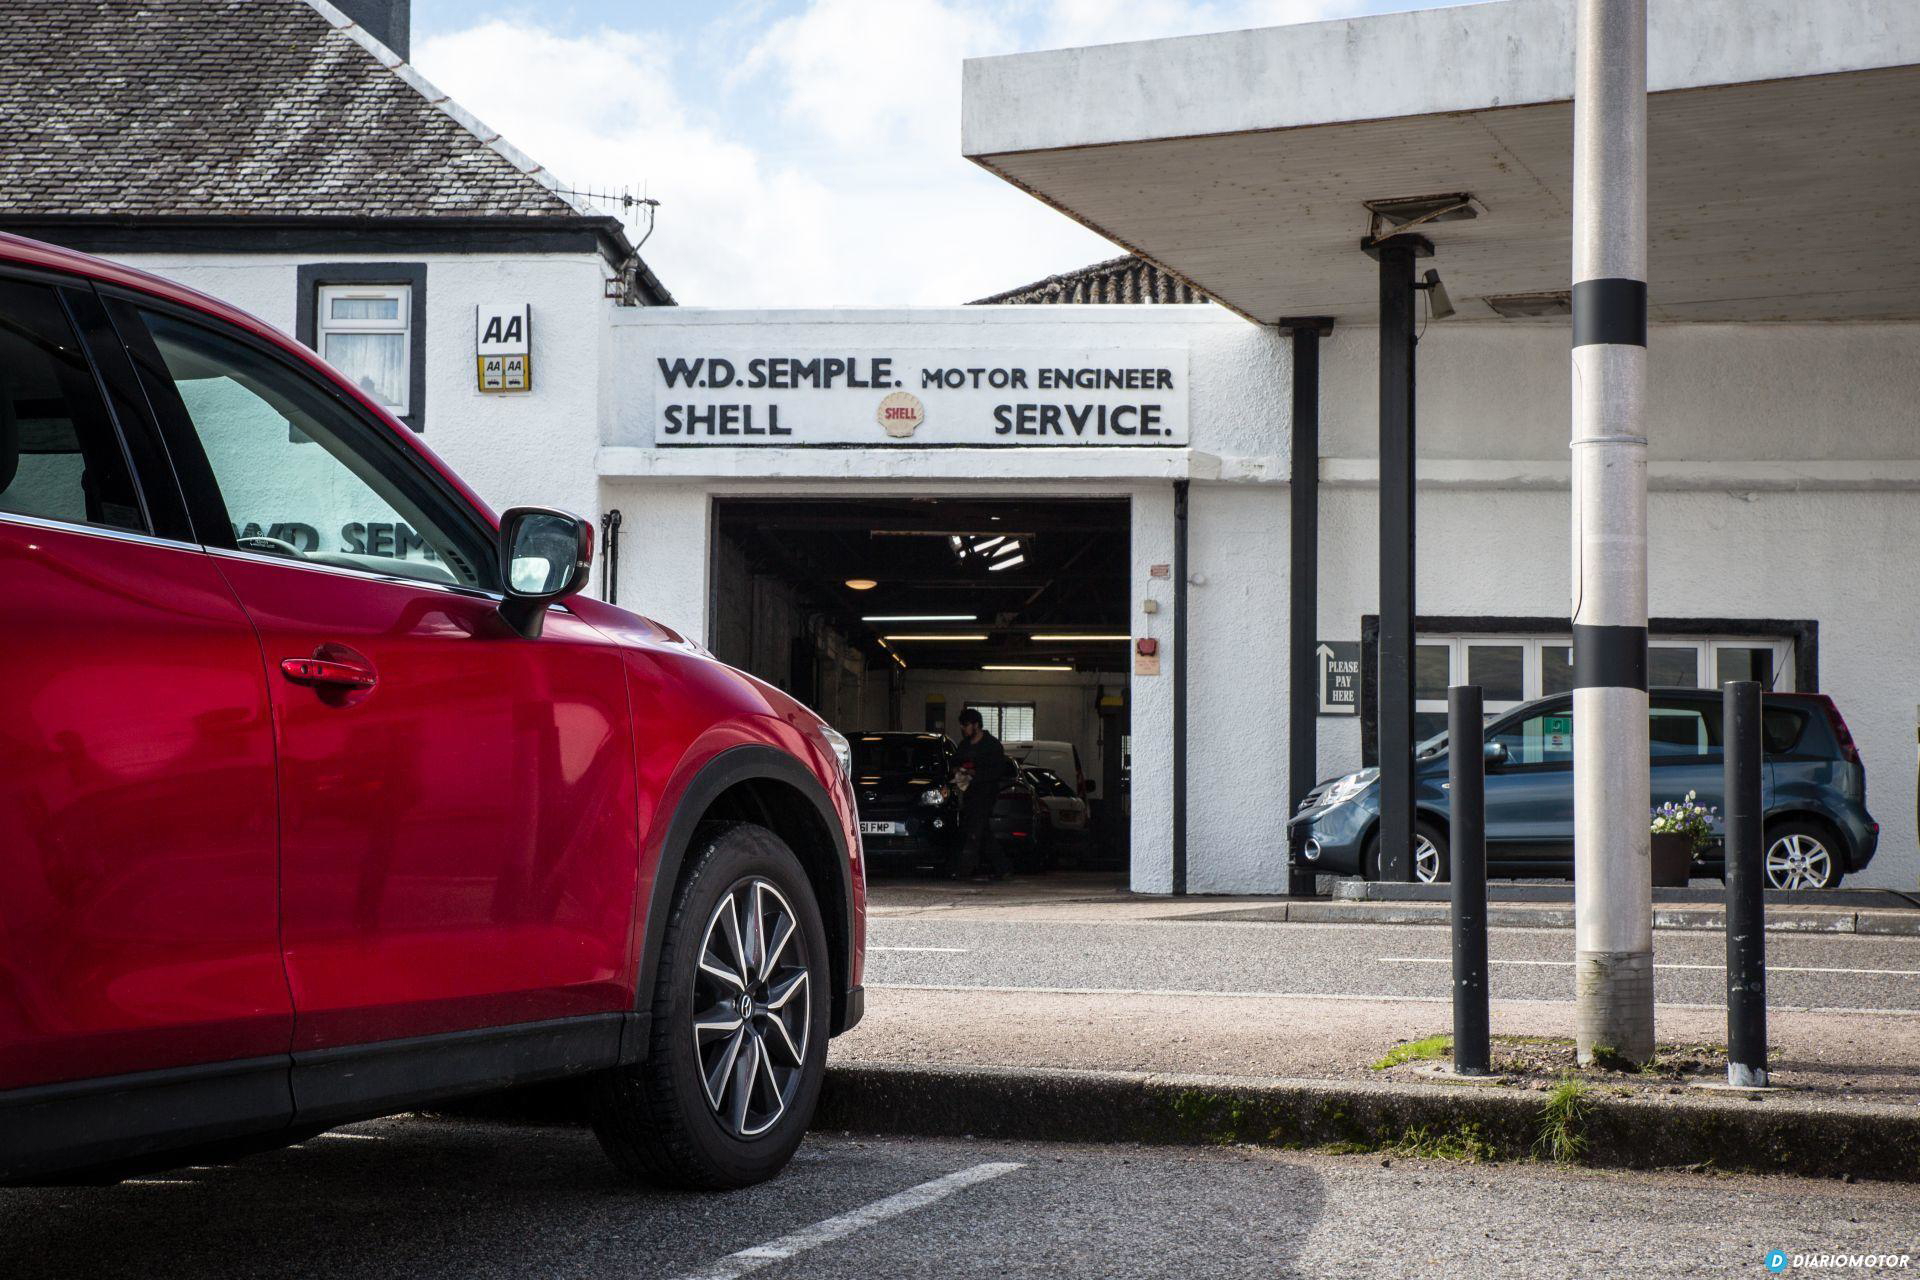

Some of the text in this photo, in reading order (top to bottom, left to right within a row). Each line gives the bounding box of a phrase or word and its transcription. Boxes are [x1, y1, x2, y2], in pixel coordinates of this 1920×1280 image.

[482, 315, 522, 344] AA
[486, 361, 501, 372] AA
[507, 360, 522, 372] AA
[921, 367, 1174, 390] MOTOR ENGINEER
[885, 407, 917, 420] SHELL
[664, 404, 792, 436] SHELL
[993, 404, 1172, 436] SERVICE.
[1328, 661, 1359, 673] PLEASE
[1335, 675, 1351, 687] PAY
[1332, 690, 1354, 702] HERE
[870, 823, 889, 832] FMP
